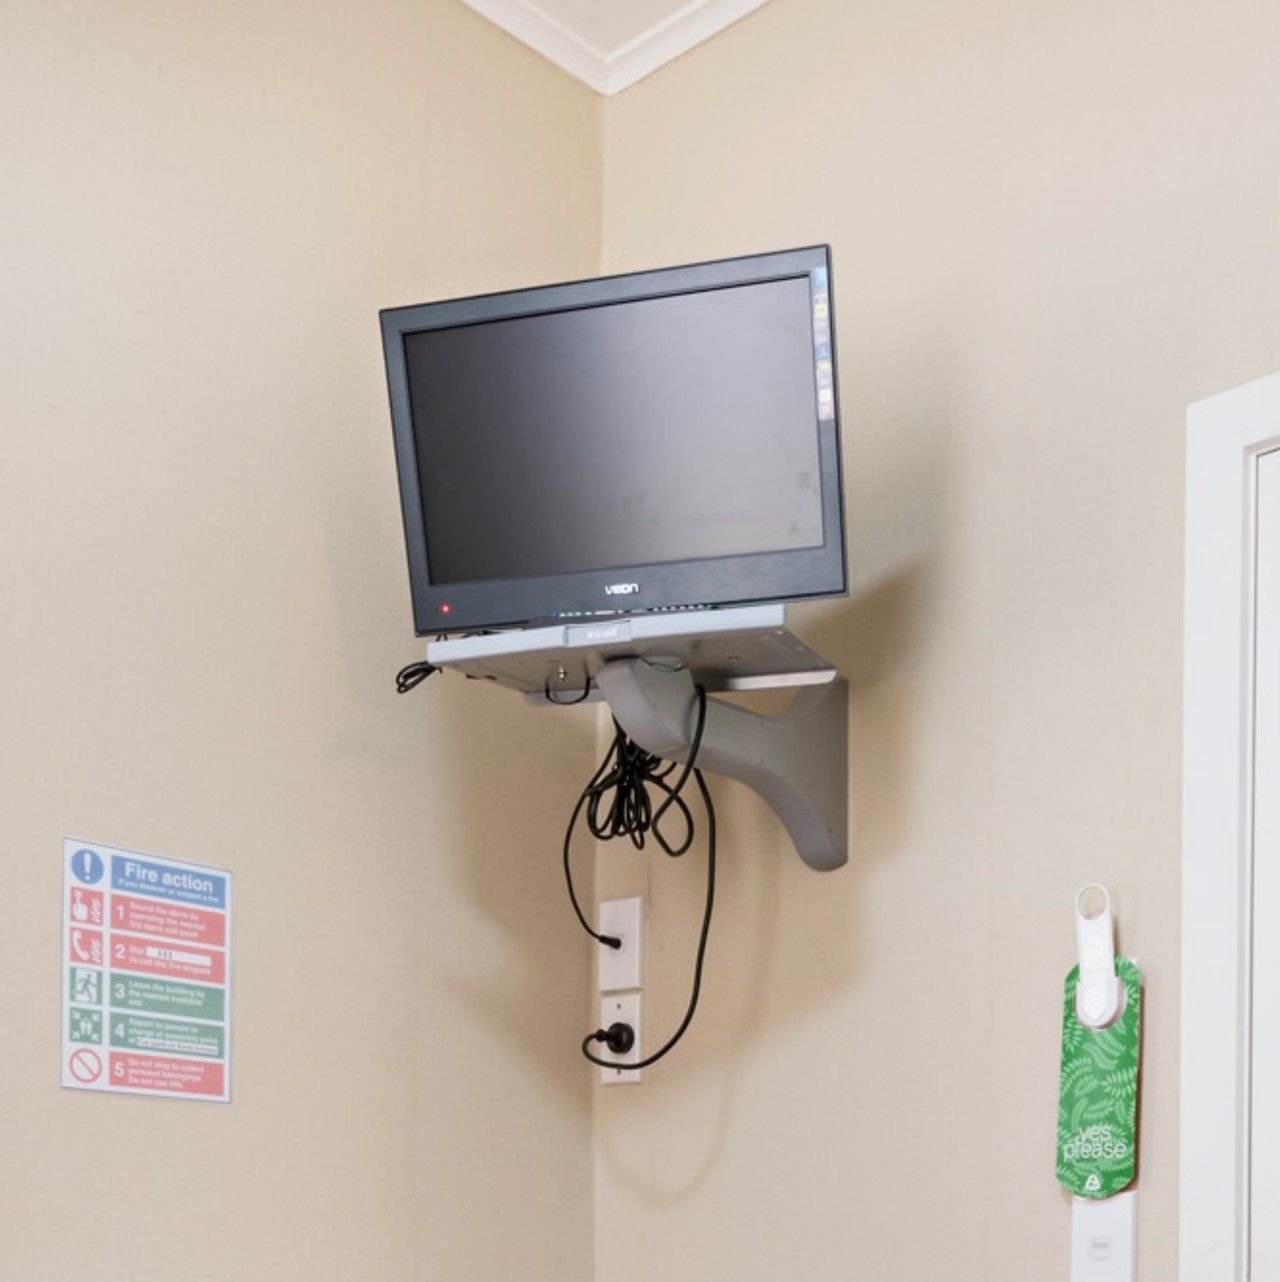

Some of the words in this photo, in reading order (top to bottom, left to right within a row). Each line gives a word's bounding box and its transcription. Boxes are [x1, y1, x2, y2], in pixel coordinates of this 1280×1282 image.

[125, 862, 157, 882] Fire
[161, 872, 214, 894] action
[115, 904, 124, 921] 1
[115, 943, 125, 960] 2
[114, 983, 125, 999] 3
[114, 1023, 124, 1038] 4
[114, 1061, 124, 1077] 5
[1075, 1124, 1111, 1145] yes
[1064, 1138, 1126, 1161] please
